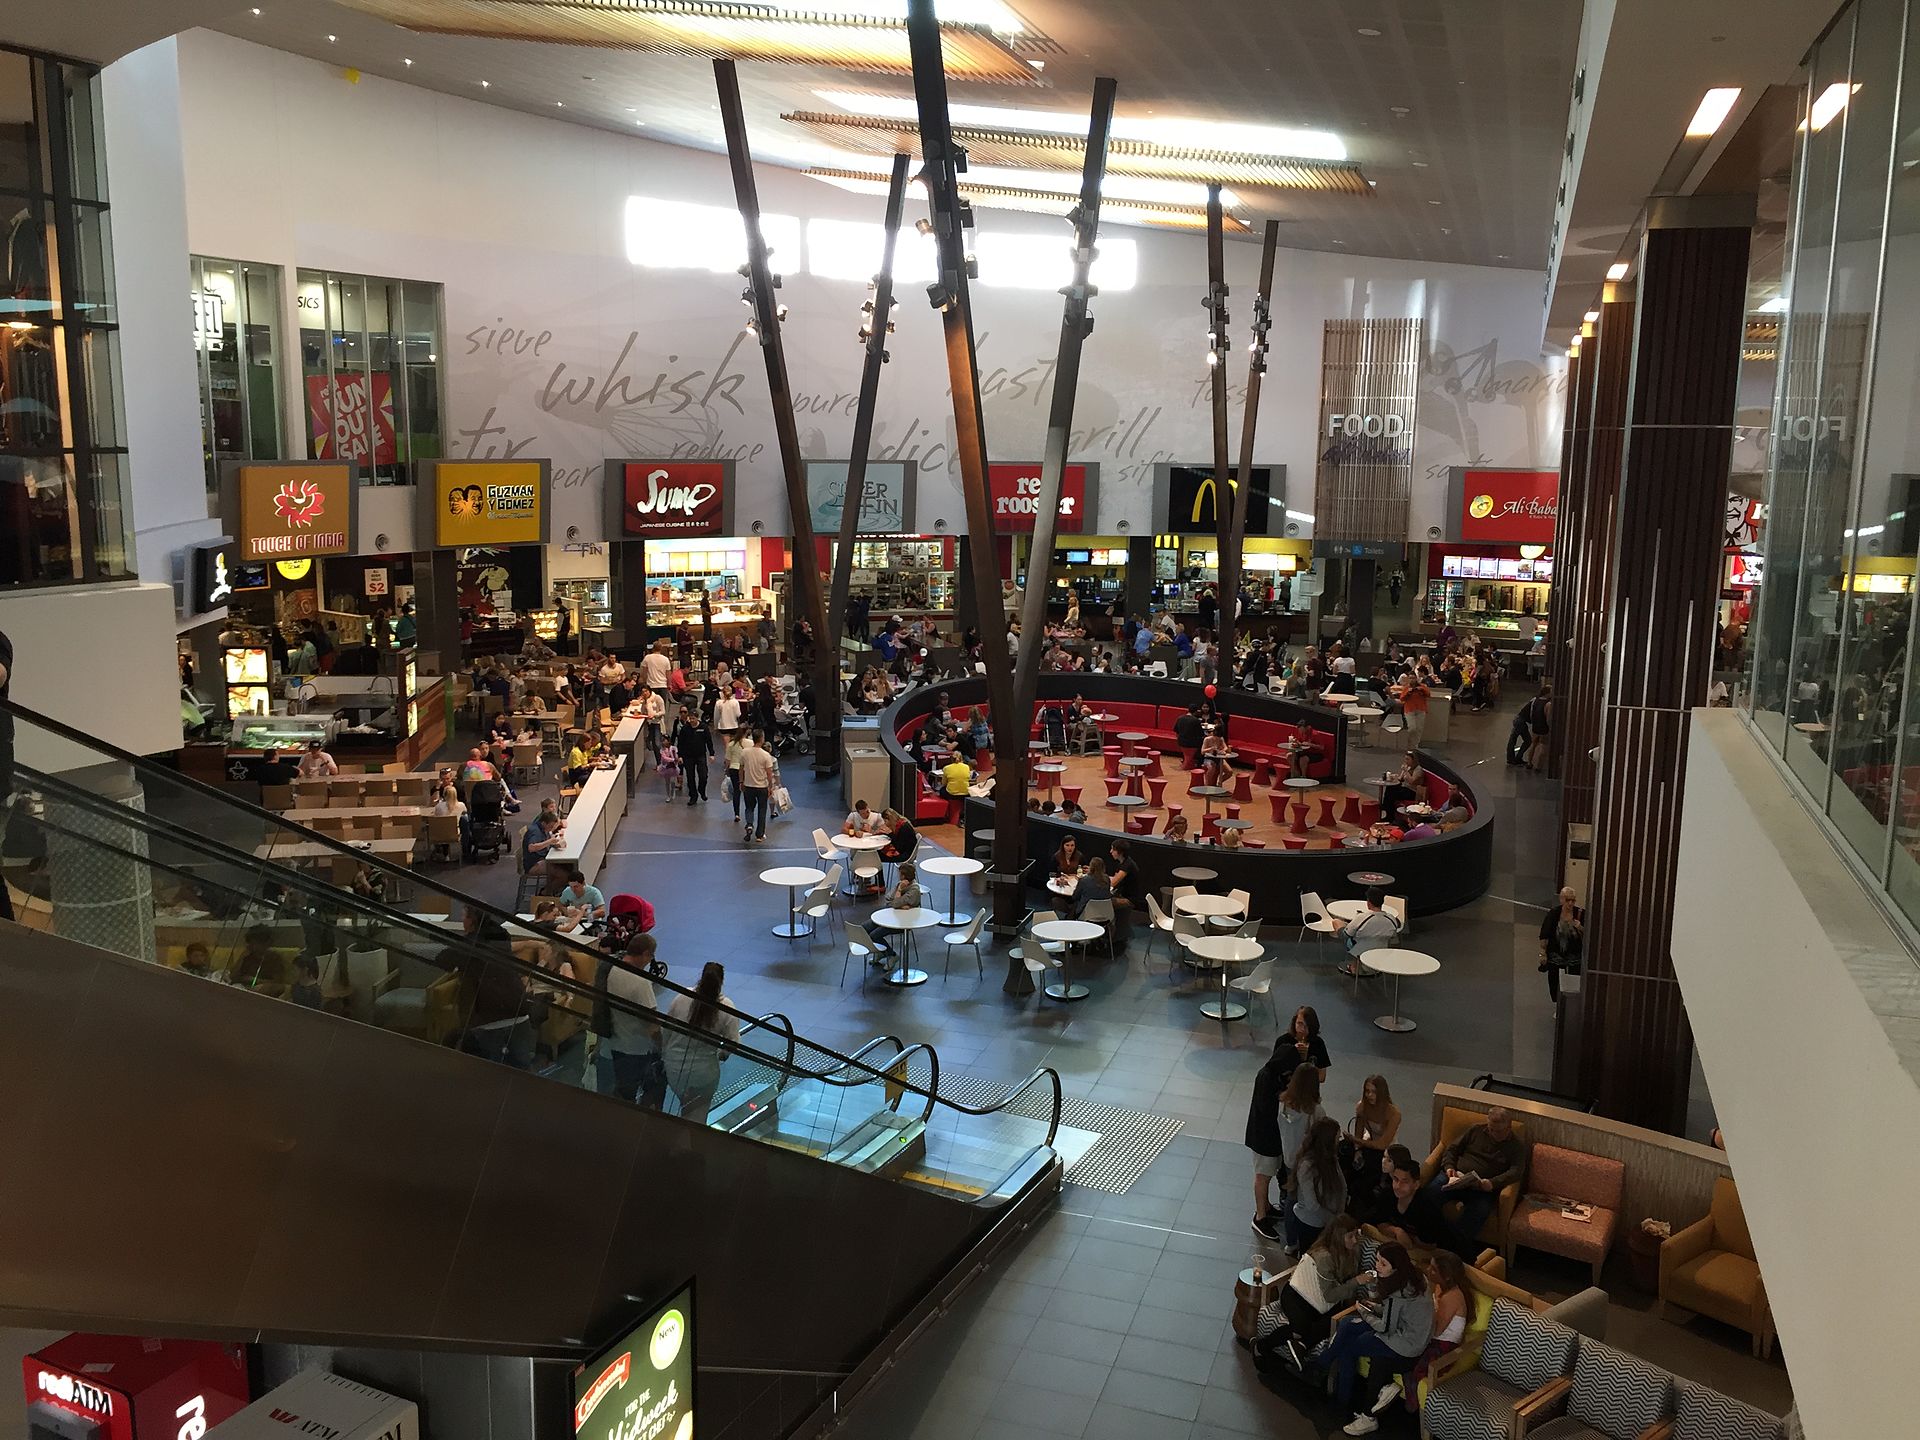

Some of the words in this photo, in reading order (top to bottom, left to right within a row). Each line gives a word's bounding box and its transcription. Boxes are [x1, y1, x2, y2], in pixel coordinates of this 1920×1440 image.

[465, 317, 552, 356] sieve
[541, 331, 748, 415] whisk
[451, 406, 537, 460] tir
[1328, 413, 1404, 438] FOOD
[667, 430, 764, 464] reduce
[551, 464, 603, 491] ear
[1017, 477, 1041, 495] re
[487, 484, 535, 499] GUZMAN
[637, 469, 717, 516] Sumo
[829, 481, 888, 498] SIER
[487, 499, 495, 511] Y
[497, 499, 535, 510] GOMEZ
[861, 496, 898, 519] FIN
[996, 496, 1075, 515] roosr
[1498, 497, 1524, 516] Ali
[1525, 496, 1558, 515] Baba
[295, 534, 311, 551] OF
[1364, 547, 1385, 555] Toilets
[658, 1323, 676, 1341] New
